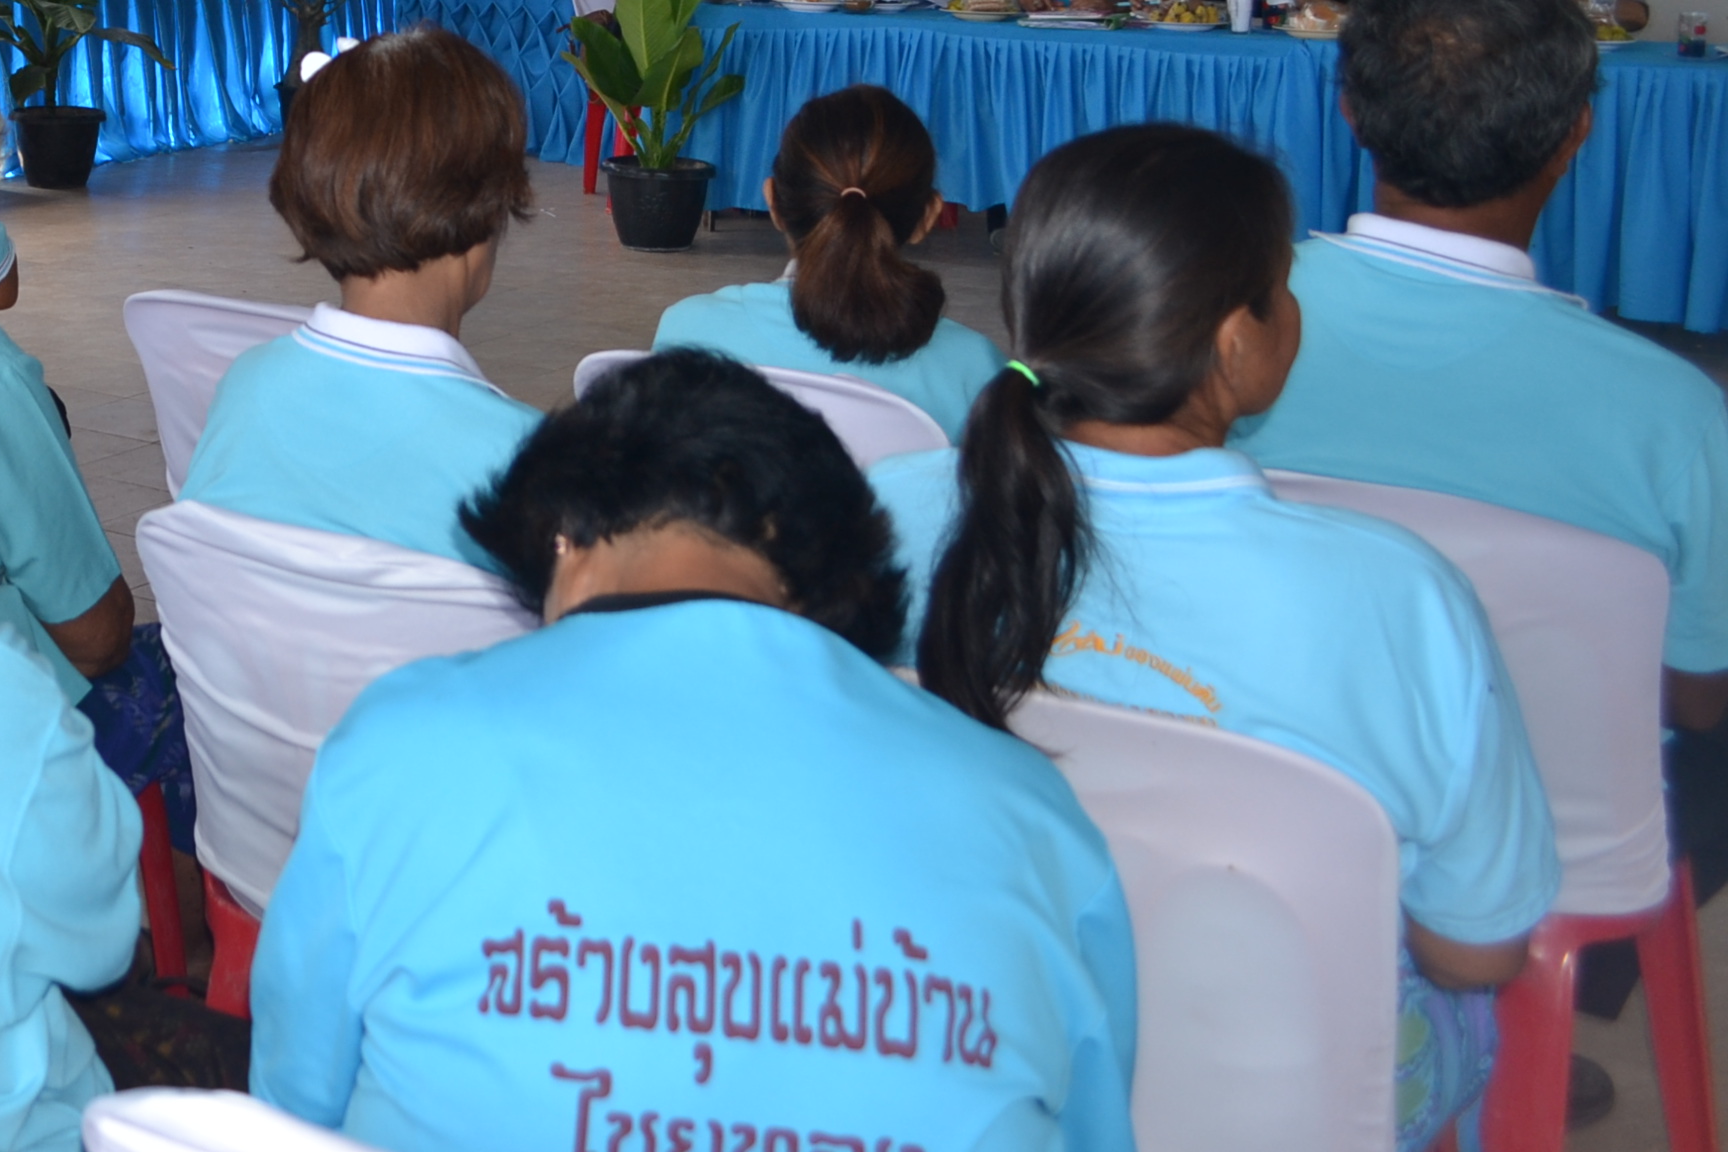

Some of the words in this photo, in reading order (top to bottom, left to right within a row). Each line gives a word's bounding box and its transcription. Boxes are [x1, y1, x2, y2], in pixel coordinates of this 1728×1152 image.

[477, 898, 999, 1086] สร้างสุขแม่บ้าน
